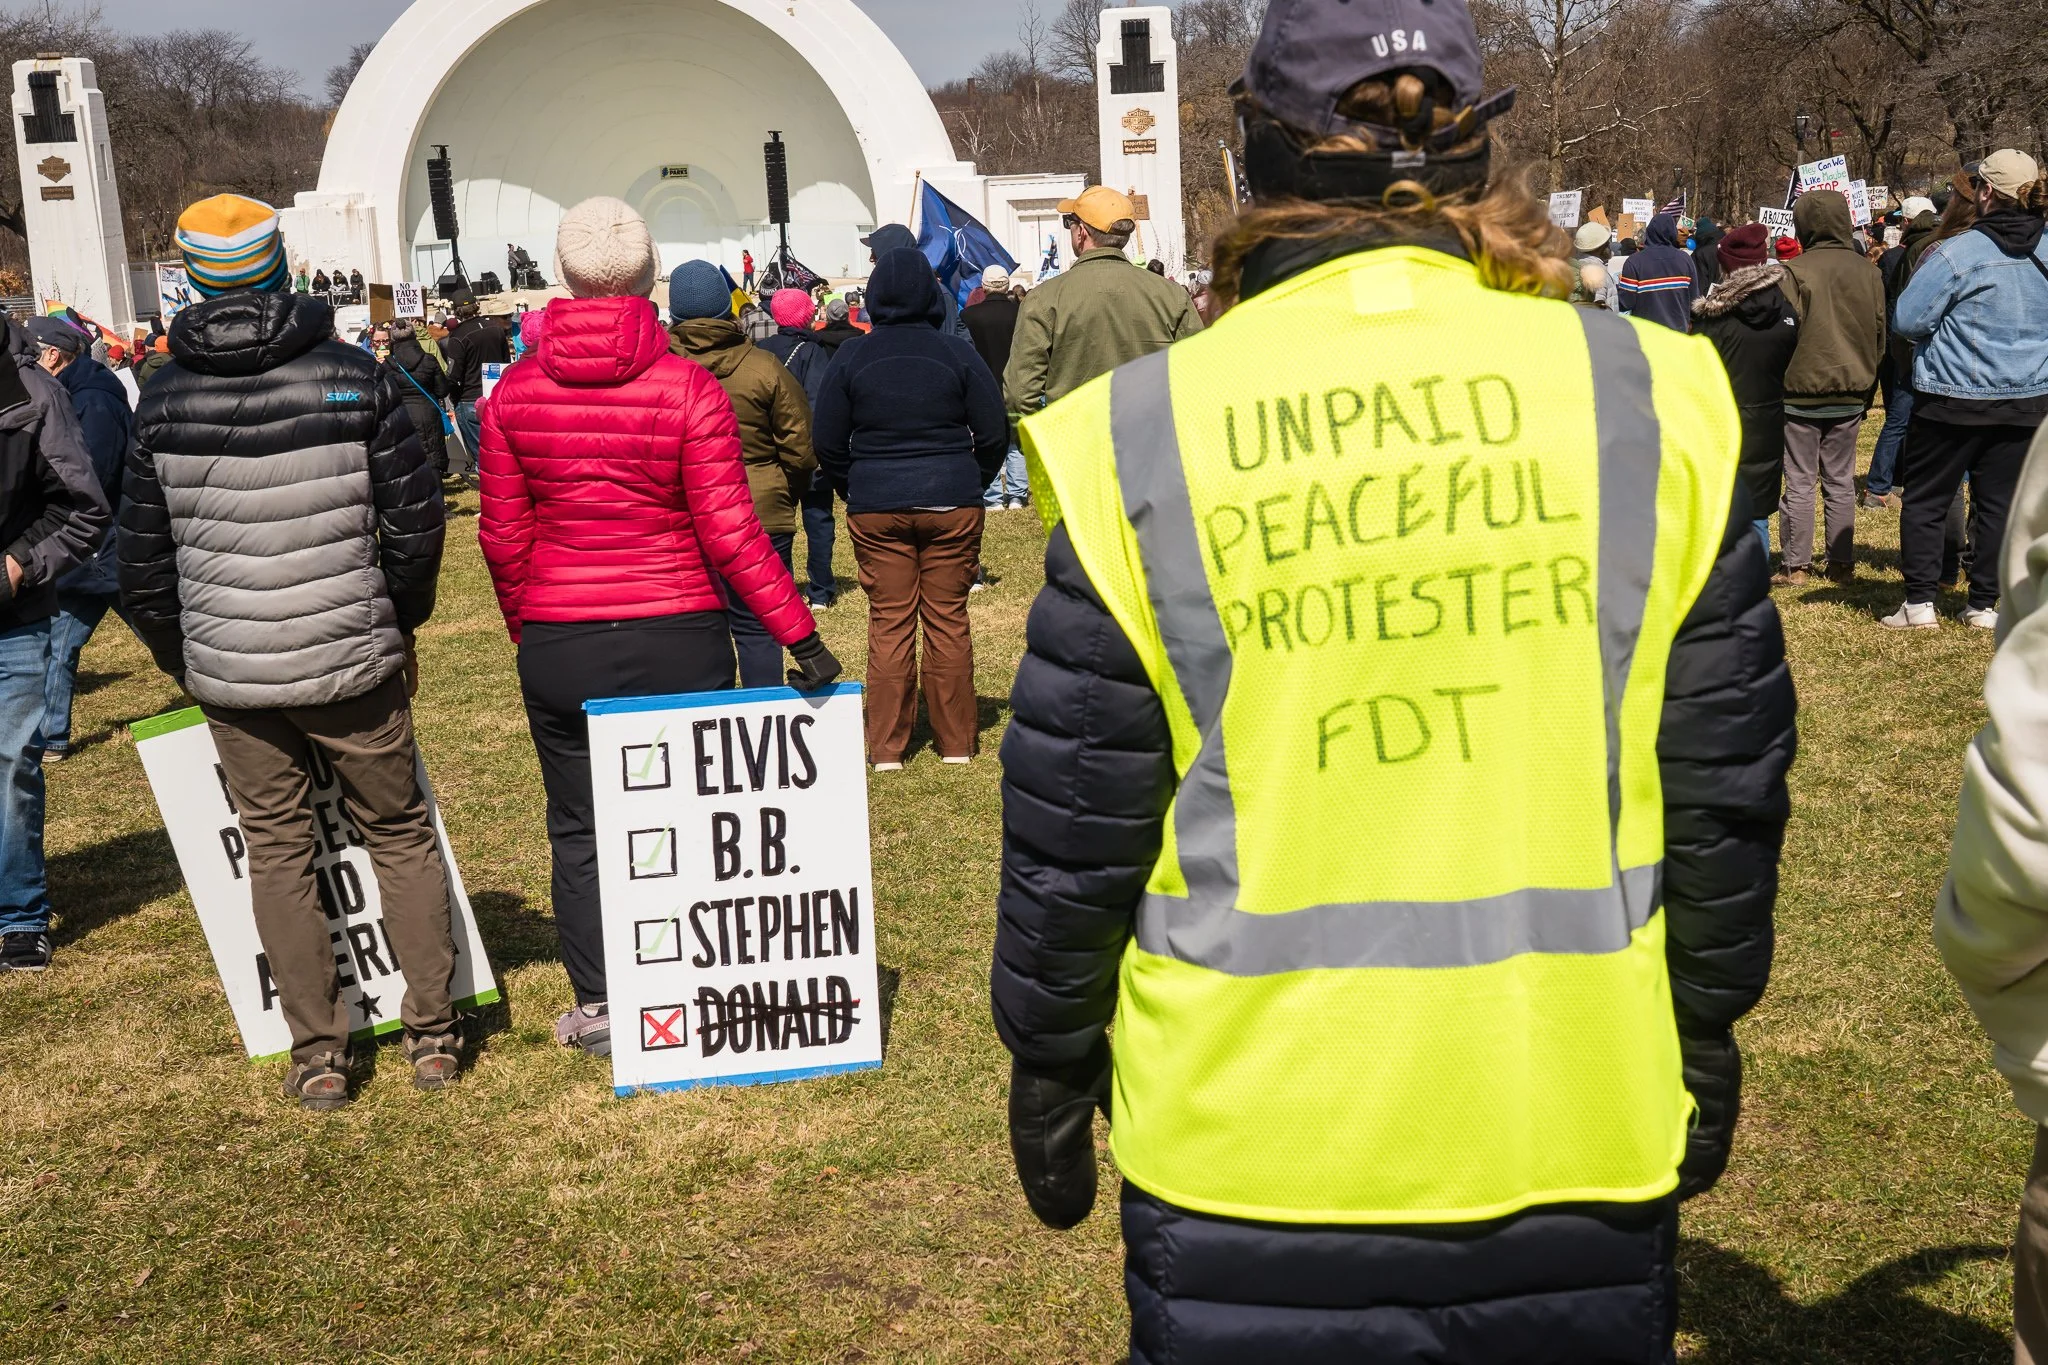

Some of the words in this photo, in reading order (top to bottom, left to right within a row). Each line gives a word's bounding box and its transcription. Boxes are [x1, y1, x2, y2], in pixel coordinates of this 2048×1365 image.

[1371, 29, 1427, 57] USA
[1802, 165, 1816, 175] Hey
[1818, 162, 1832, 171] Can
[1832, 157, 1844, 166] We
[1762, 210, 1794, 227] ABOLISH
[395, 289, 418, 297] FAUX
[397, 297, 417, 305] KING
[399, 305, 416, 313] WAY
[400, 282, 410, 290] NO
[1225, 374, 1521, 472] UNPAID
[1204, 456, 1581, 577] PEACEFUL
[1220, 554, 1595, 653] PROTESTER
[691, 713, 818, 796] ELVIS
[1317, 684, 1500, 773] FDT
[711, 806, 801, 882] B.B.
[688, 886, 860, 969] STEPHEN
[696, 975, 853, 1059] DONALD
